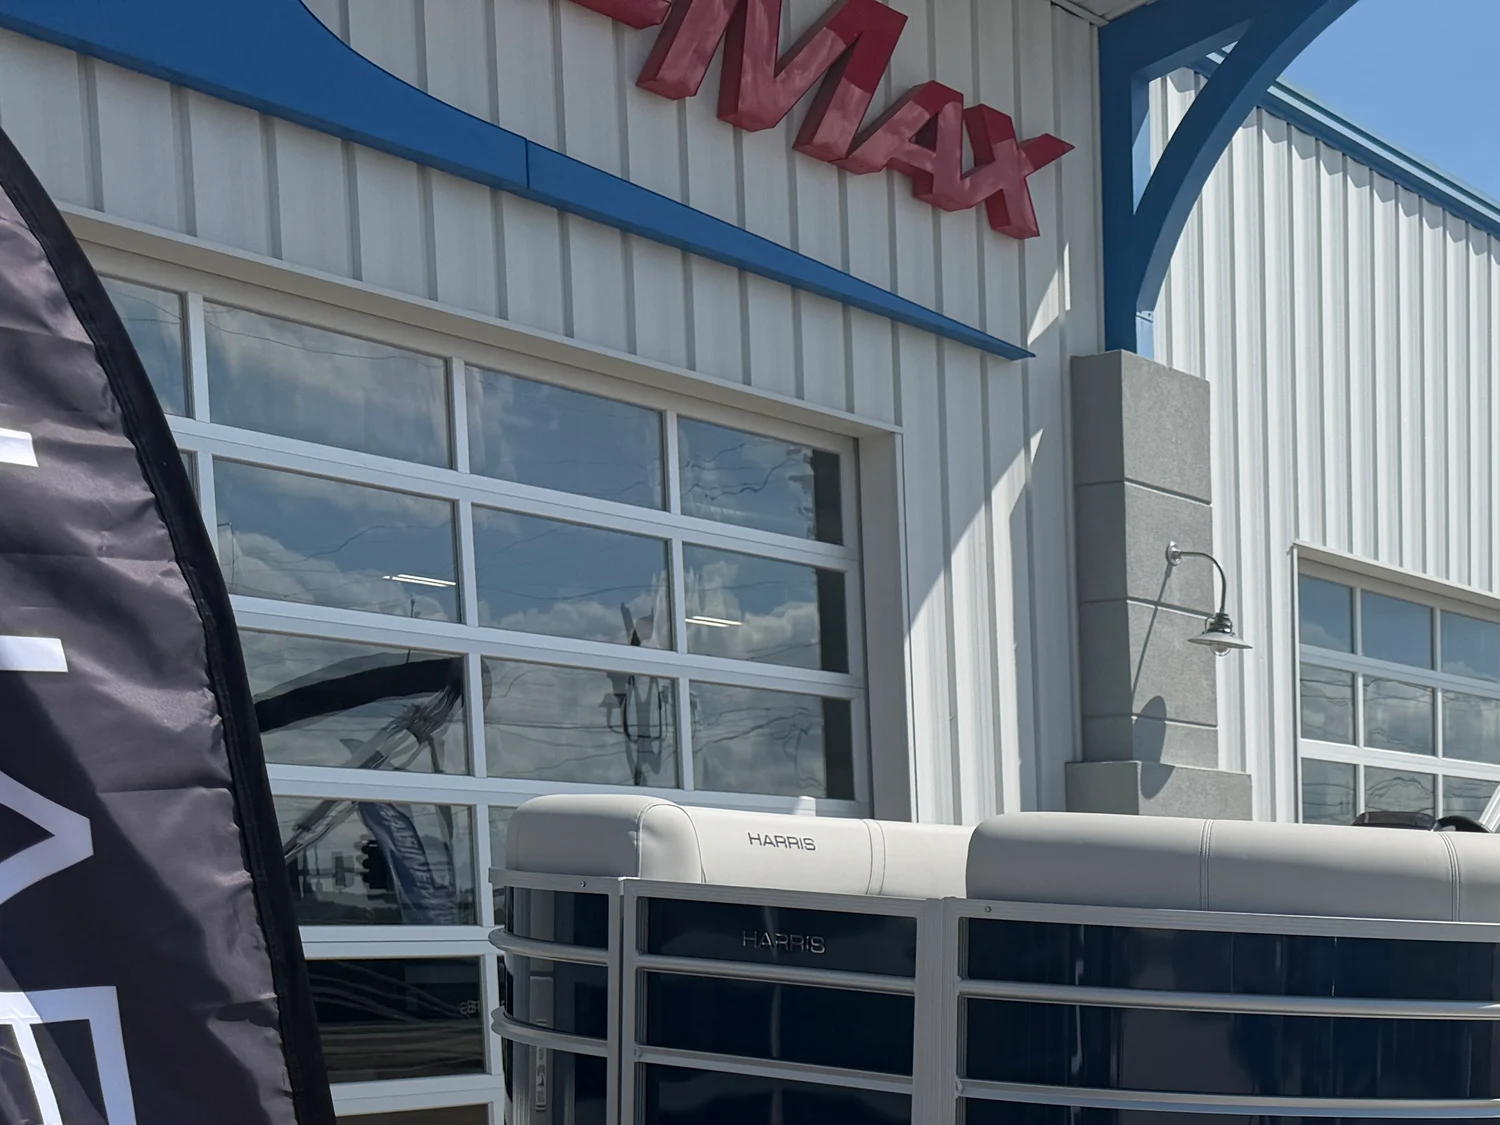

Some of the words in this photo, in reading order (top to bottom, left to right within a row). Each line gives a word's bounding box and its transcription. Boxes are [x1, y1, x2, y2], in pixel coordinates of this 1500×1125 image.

[568, 0, 1075, 240] MAX
[747, 832, 816, 851] HARRIS
[743, 930, 826, 954] HARRIS
